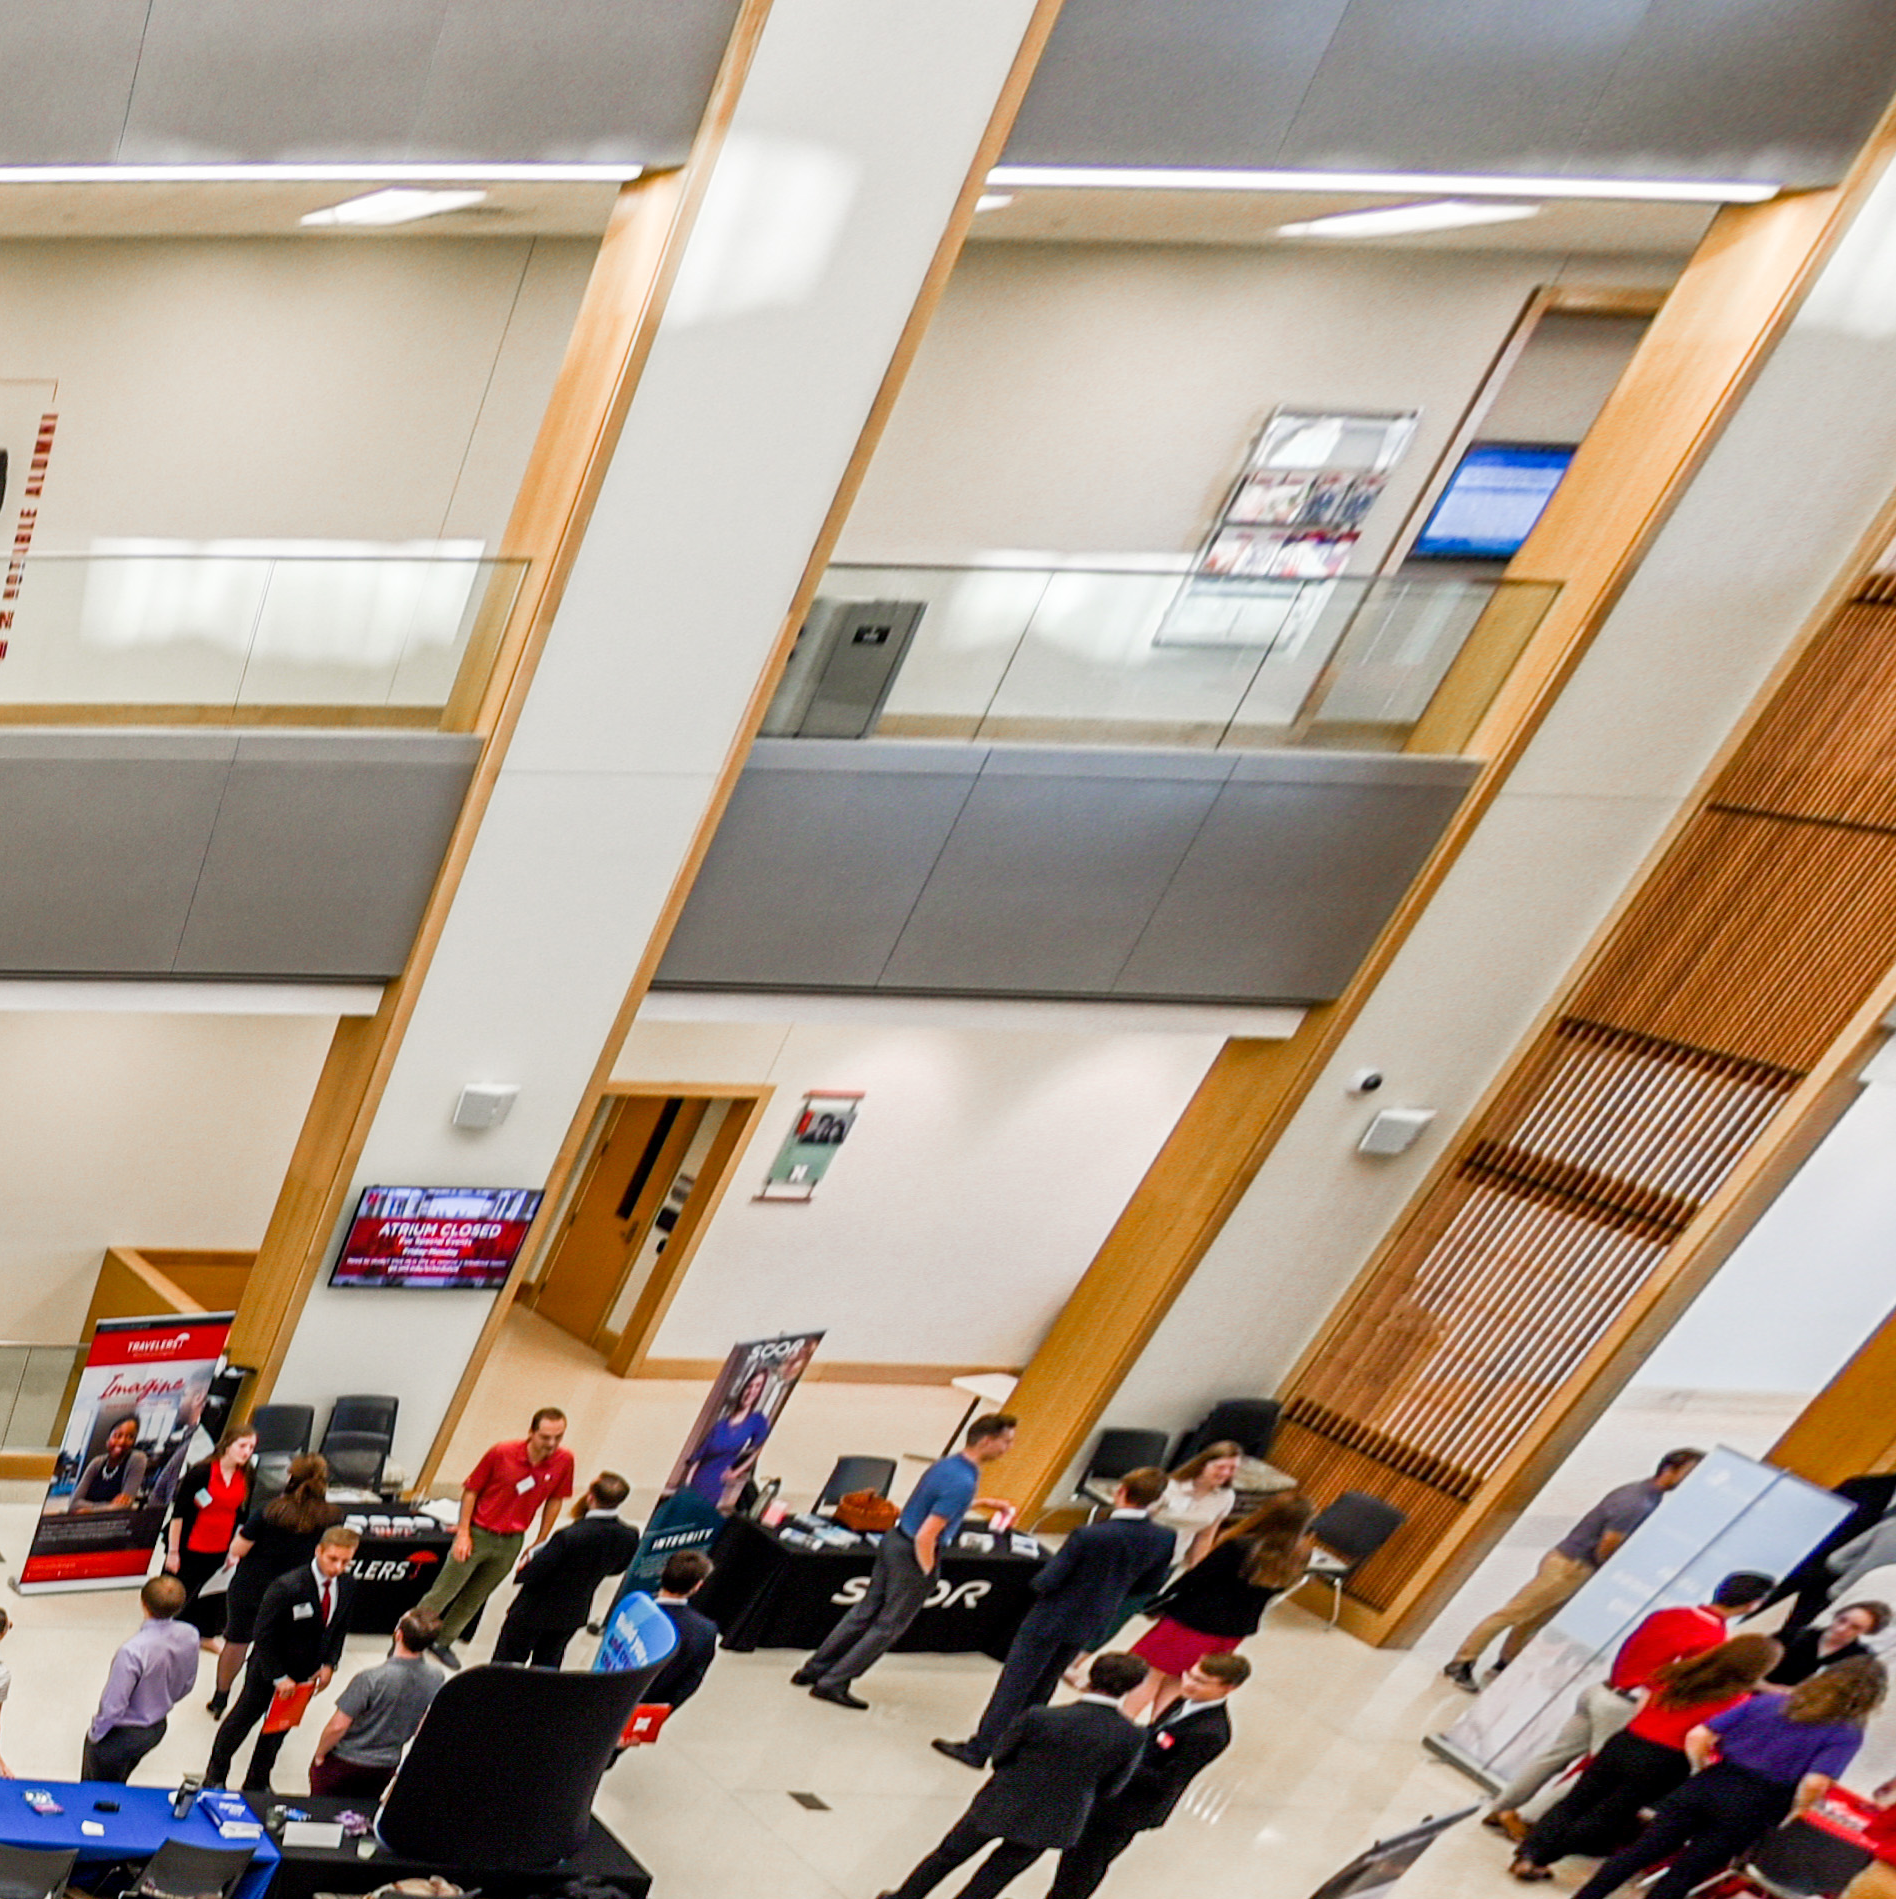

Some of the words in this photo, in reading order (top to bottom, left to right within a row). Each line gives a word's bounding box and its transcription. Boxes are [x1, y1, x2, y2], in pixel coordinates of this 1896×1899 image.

[378, 1222, 438, 1237] ATRIUM
[439, 1223, 503, 1238] CLOSED
[127, 1339, 178, 1354] TRAVELERS
[748, 1337, 807, 1361] SCOR
[98, 1373, 186, 1403] Imagine
[651, 1527, 715, 1552] INTEGRITY
